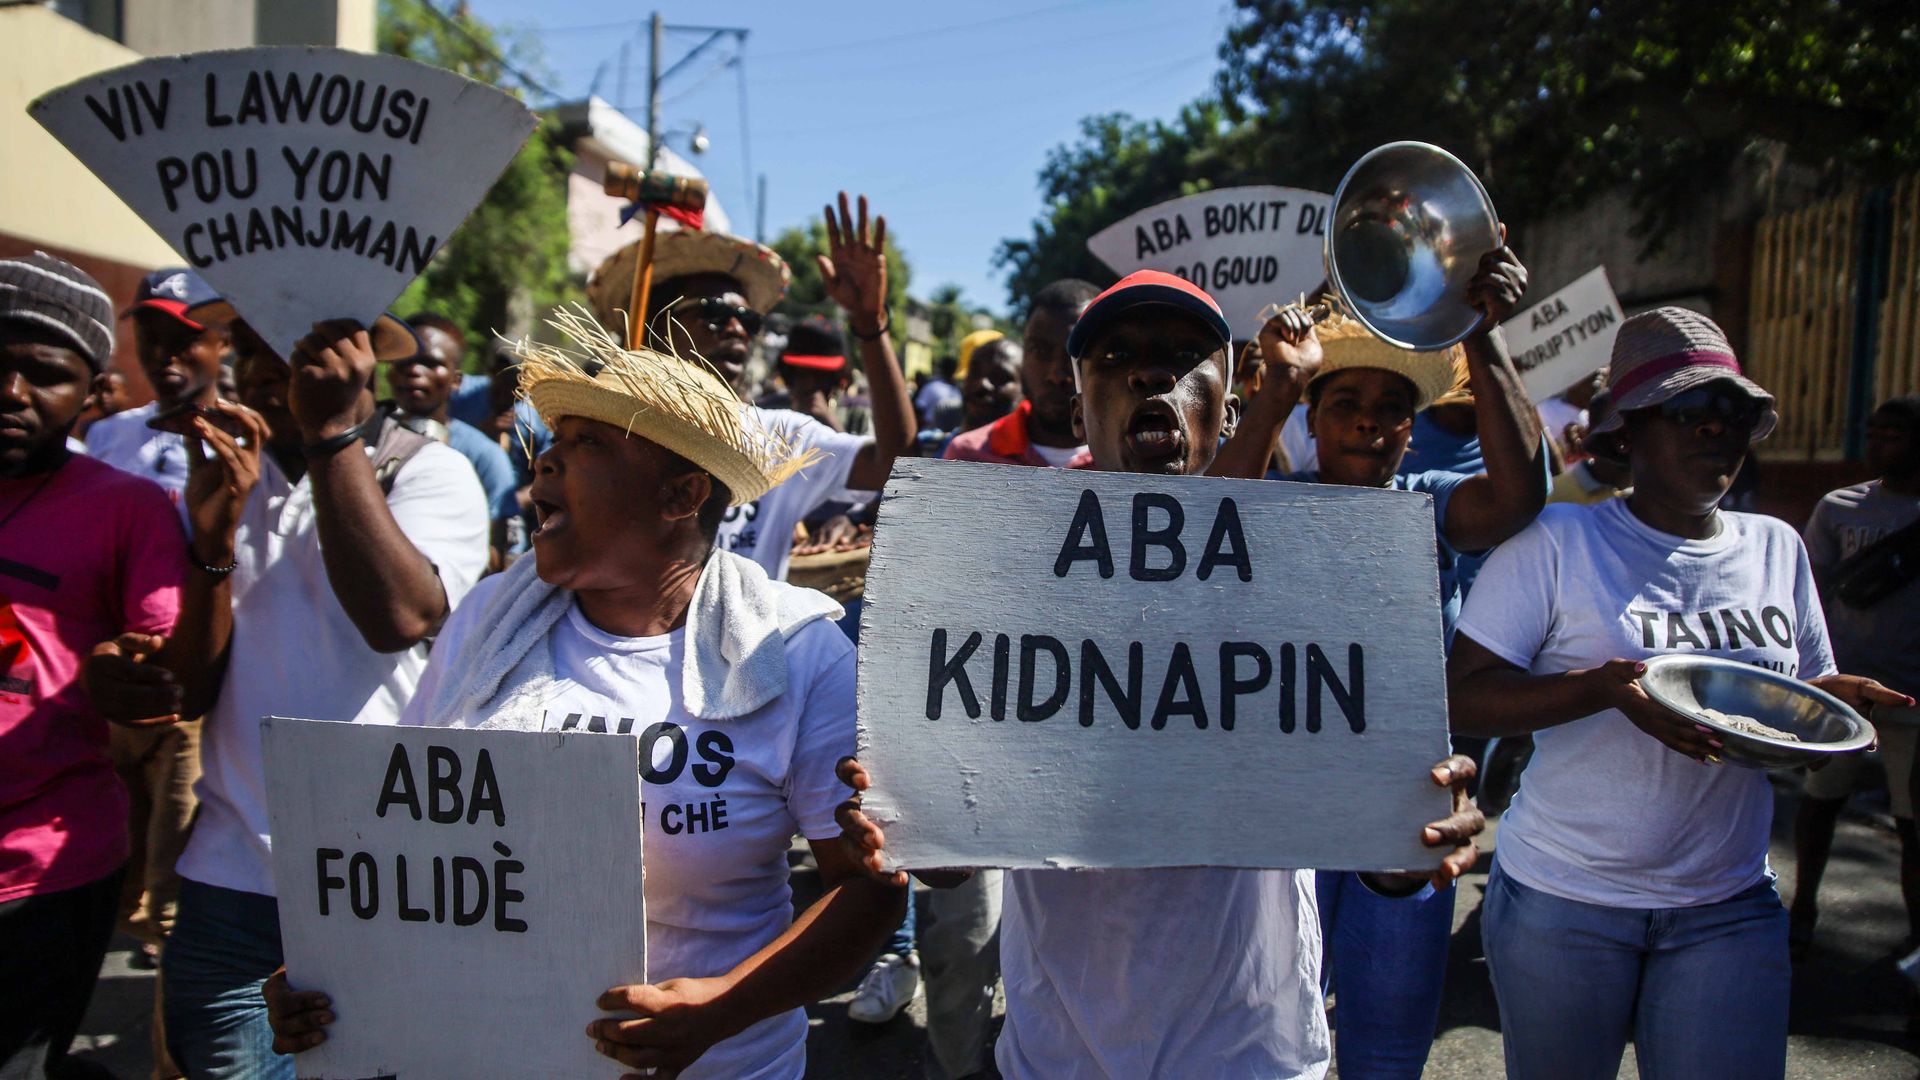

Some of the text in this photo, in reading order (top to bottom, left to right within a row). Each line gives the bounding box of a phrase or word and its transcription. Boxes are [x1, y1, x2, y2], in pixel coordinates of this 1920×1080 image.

[84, 70, 430, 144] VIV LAWOUSI
[156, 146, 392, 211] POU YON
[183, 205, 437, 276] CHANJMAN
[1135, 201, 1324, 260] ABA BOKIT DL
[1212, 255, 1279, 290] GOUD
[1530, 298, 1569, 332] ABA
[1054, 488, 1252, 582] ABA
[1630, 605, 1794, 650] TAINO
[926, 628, 1366, 734] KIDNAPIN
[376, 742, 506, 827] ABA
[660, 793, 729, 836] CHÈ
[316, 840, 529, 933] FO LIDÈ
